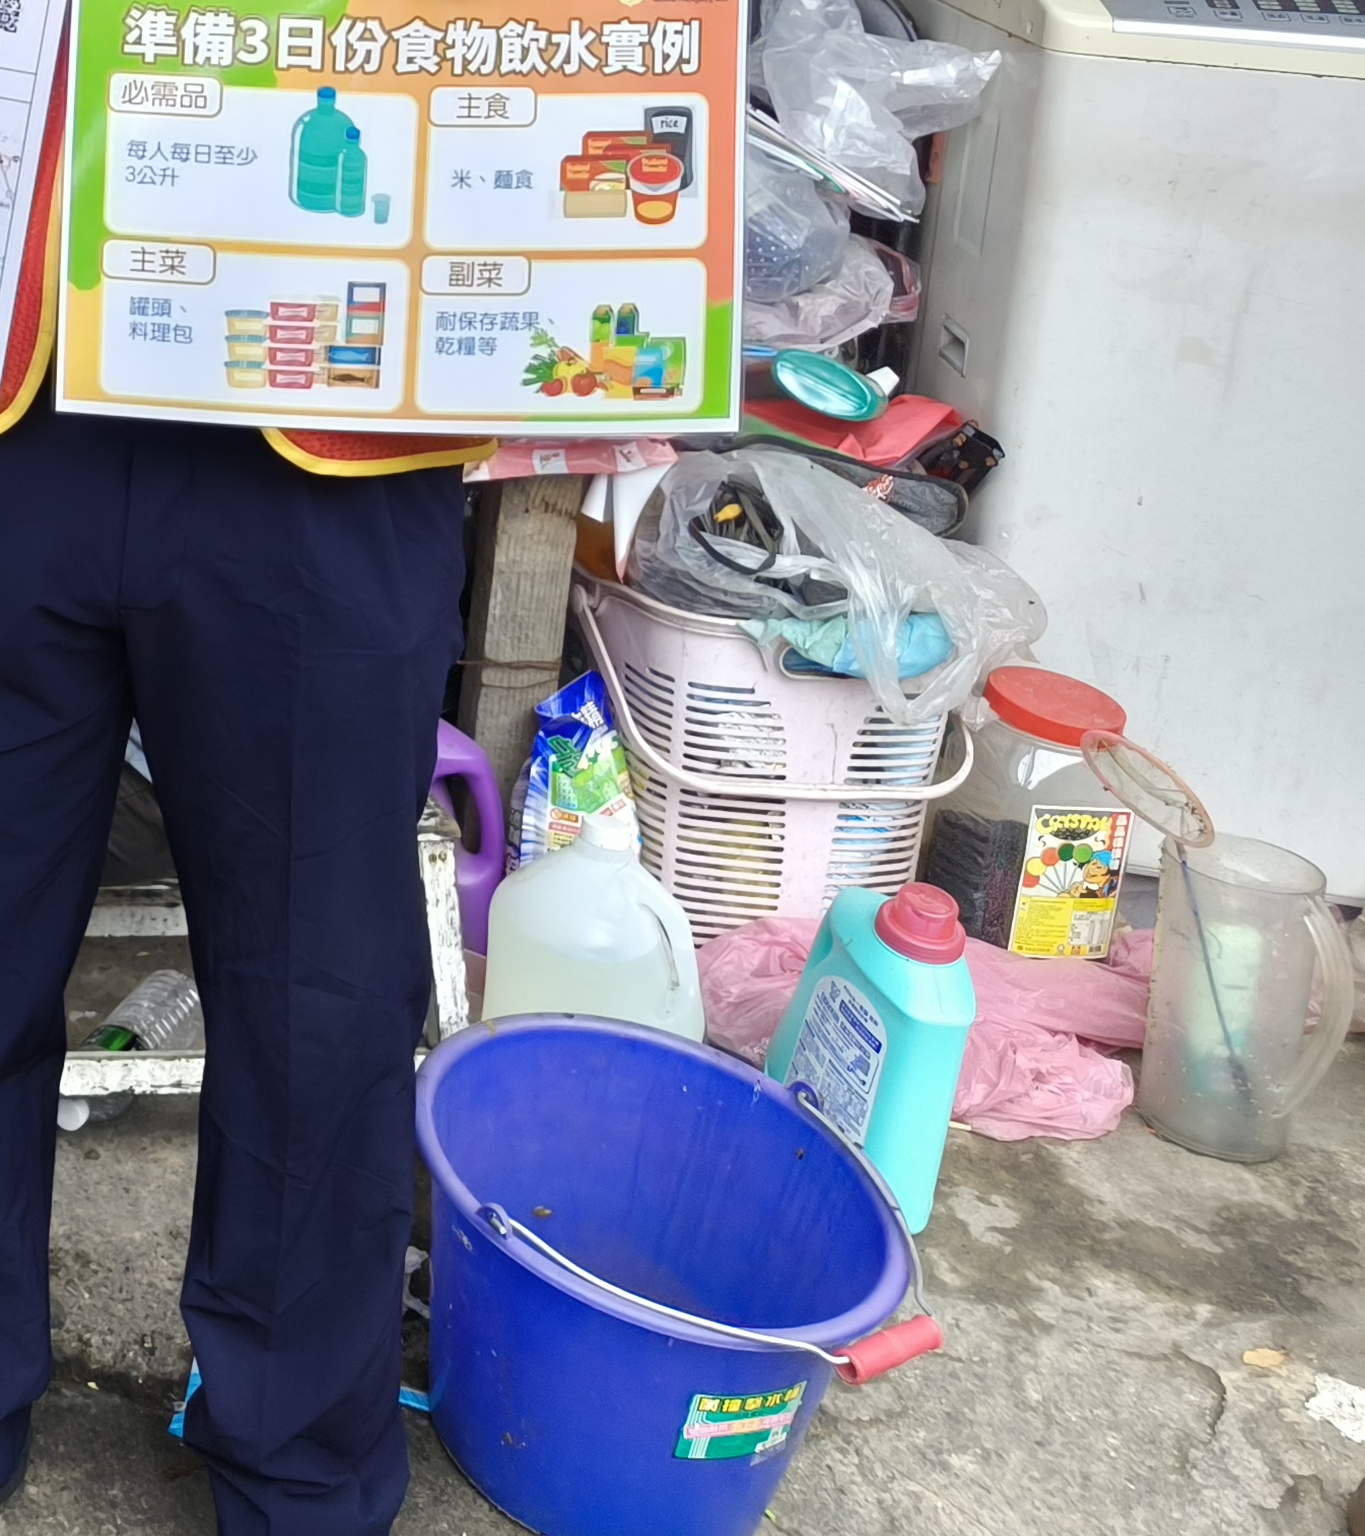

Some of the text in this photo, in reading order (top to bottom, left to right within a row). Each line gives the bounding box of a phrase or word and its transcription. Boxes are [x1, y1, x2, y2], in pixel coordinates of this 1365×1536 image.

[122, 4, 702, 78] 準備3日份食物飲水實例
[120, 78, 209, 112] 必需品
[455, 91, 511, 121] 主食
[660, 117, 679, 129] rice
[125, 139, 260, 167] 每人每日至少
[124, 163, 180, 188] 3公升
[449, 167, 535, 193] 米、麵食
[128, 246, 187, 276] 主菜
[447, 260, 505, 290] 副菜
[129, 296, 189, 320] 罐頭、
[128, 319, 194, 344] 料理包
[434, 310, 556, 334] 耐保存蔬果、
[434, 333, 498, 357] 乾糧等
